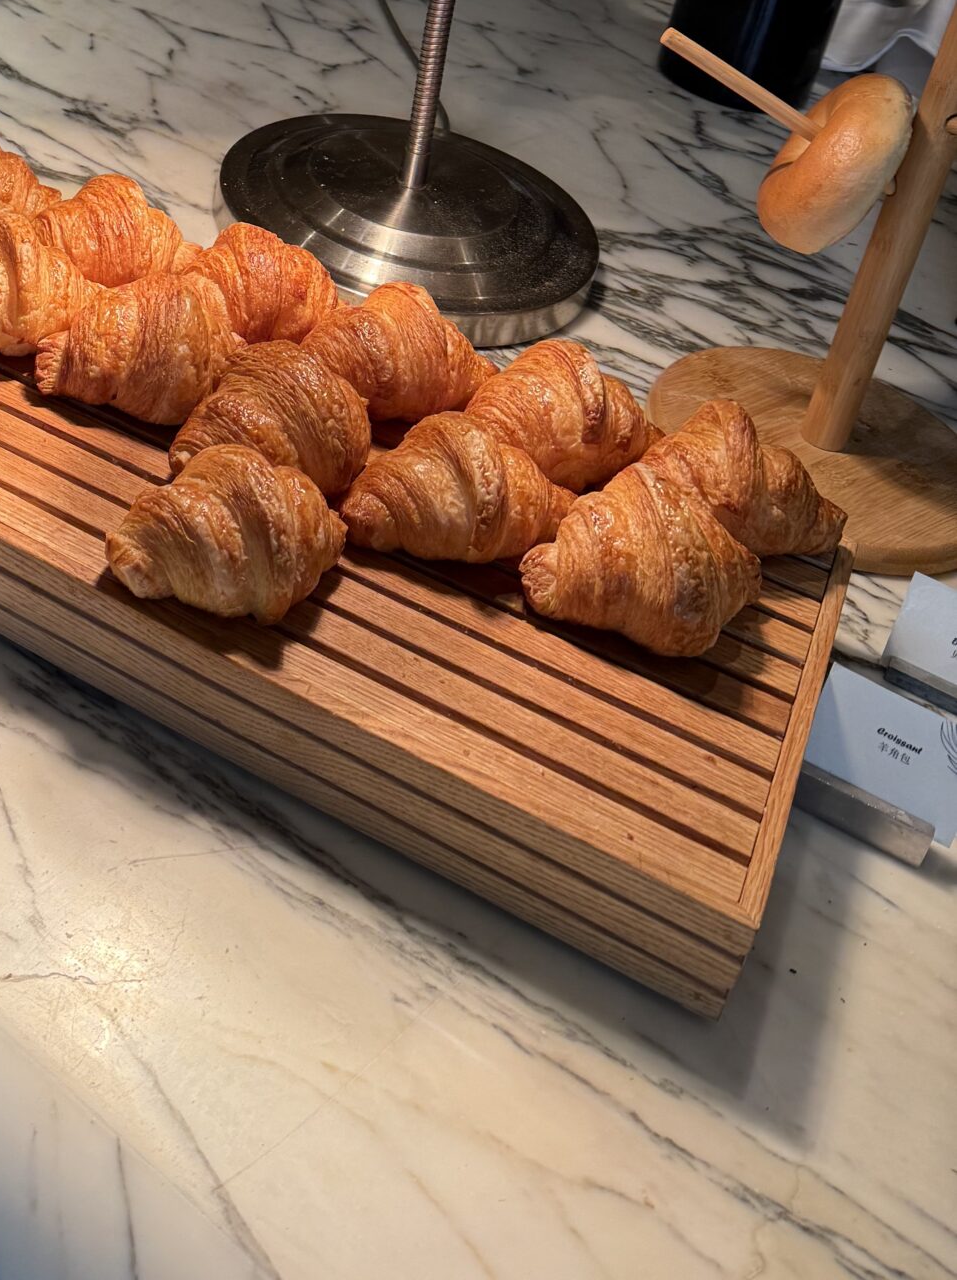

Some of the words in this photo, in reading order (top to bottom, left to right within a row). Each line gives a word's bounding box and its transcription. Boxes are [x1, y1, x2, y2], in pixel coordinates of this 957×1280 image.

[877, 727, 923, 754] Croissant
[878, 741, 911, 765] 羊角包
